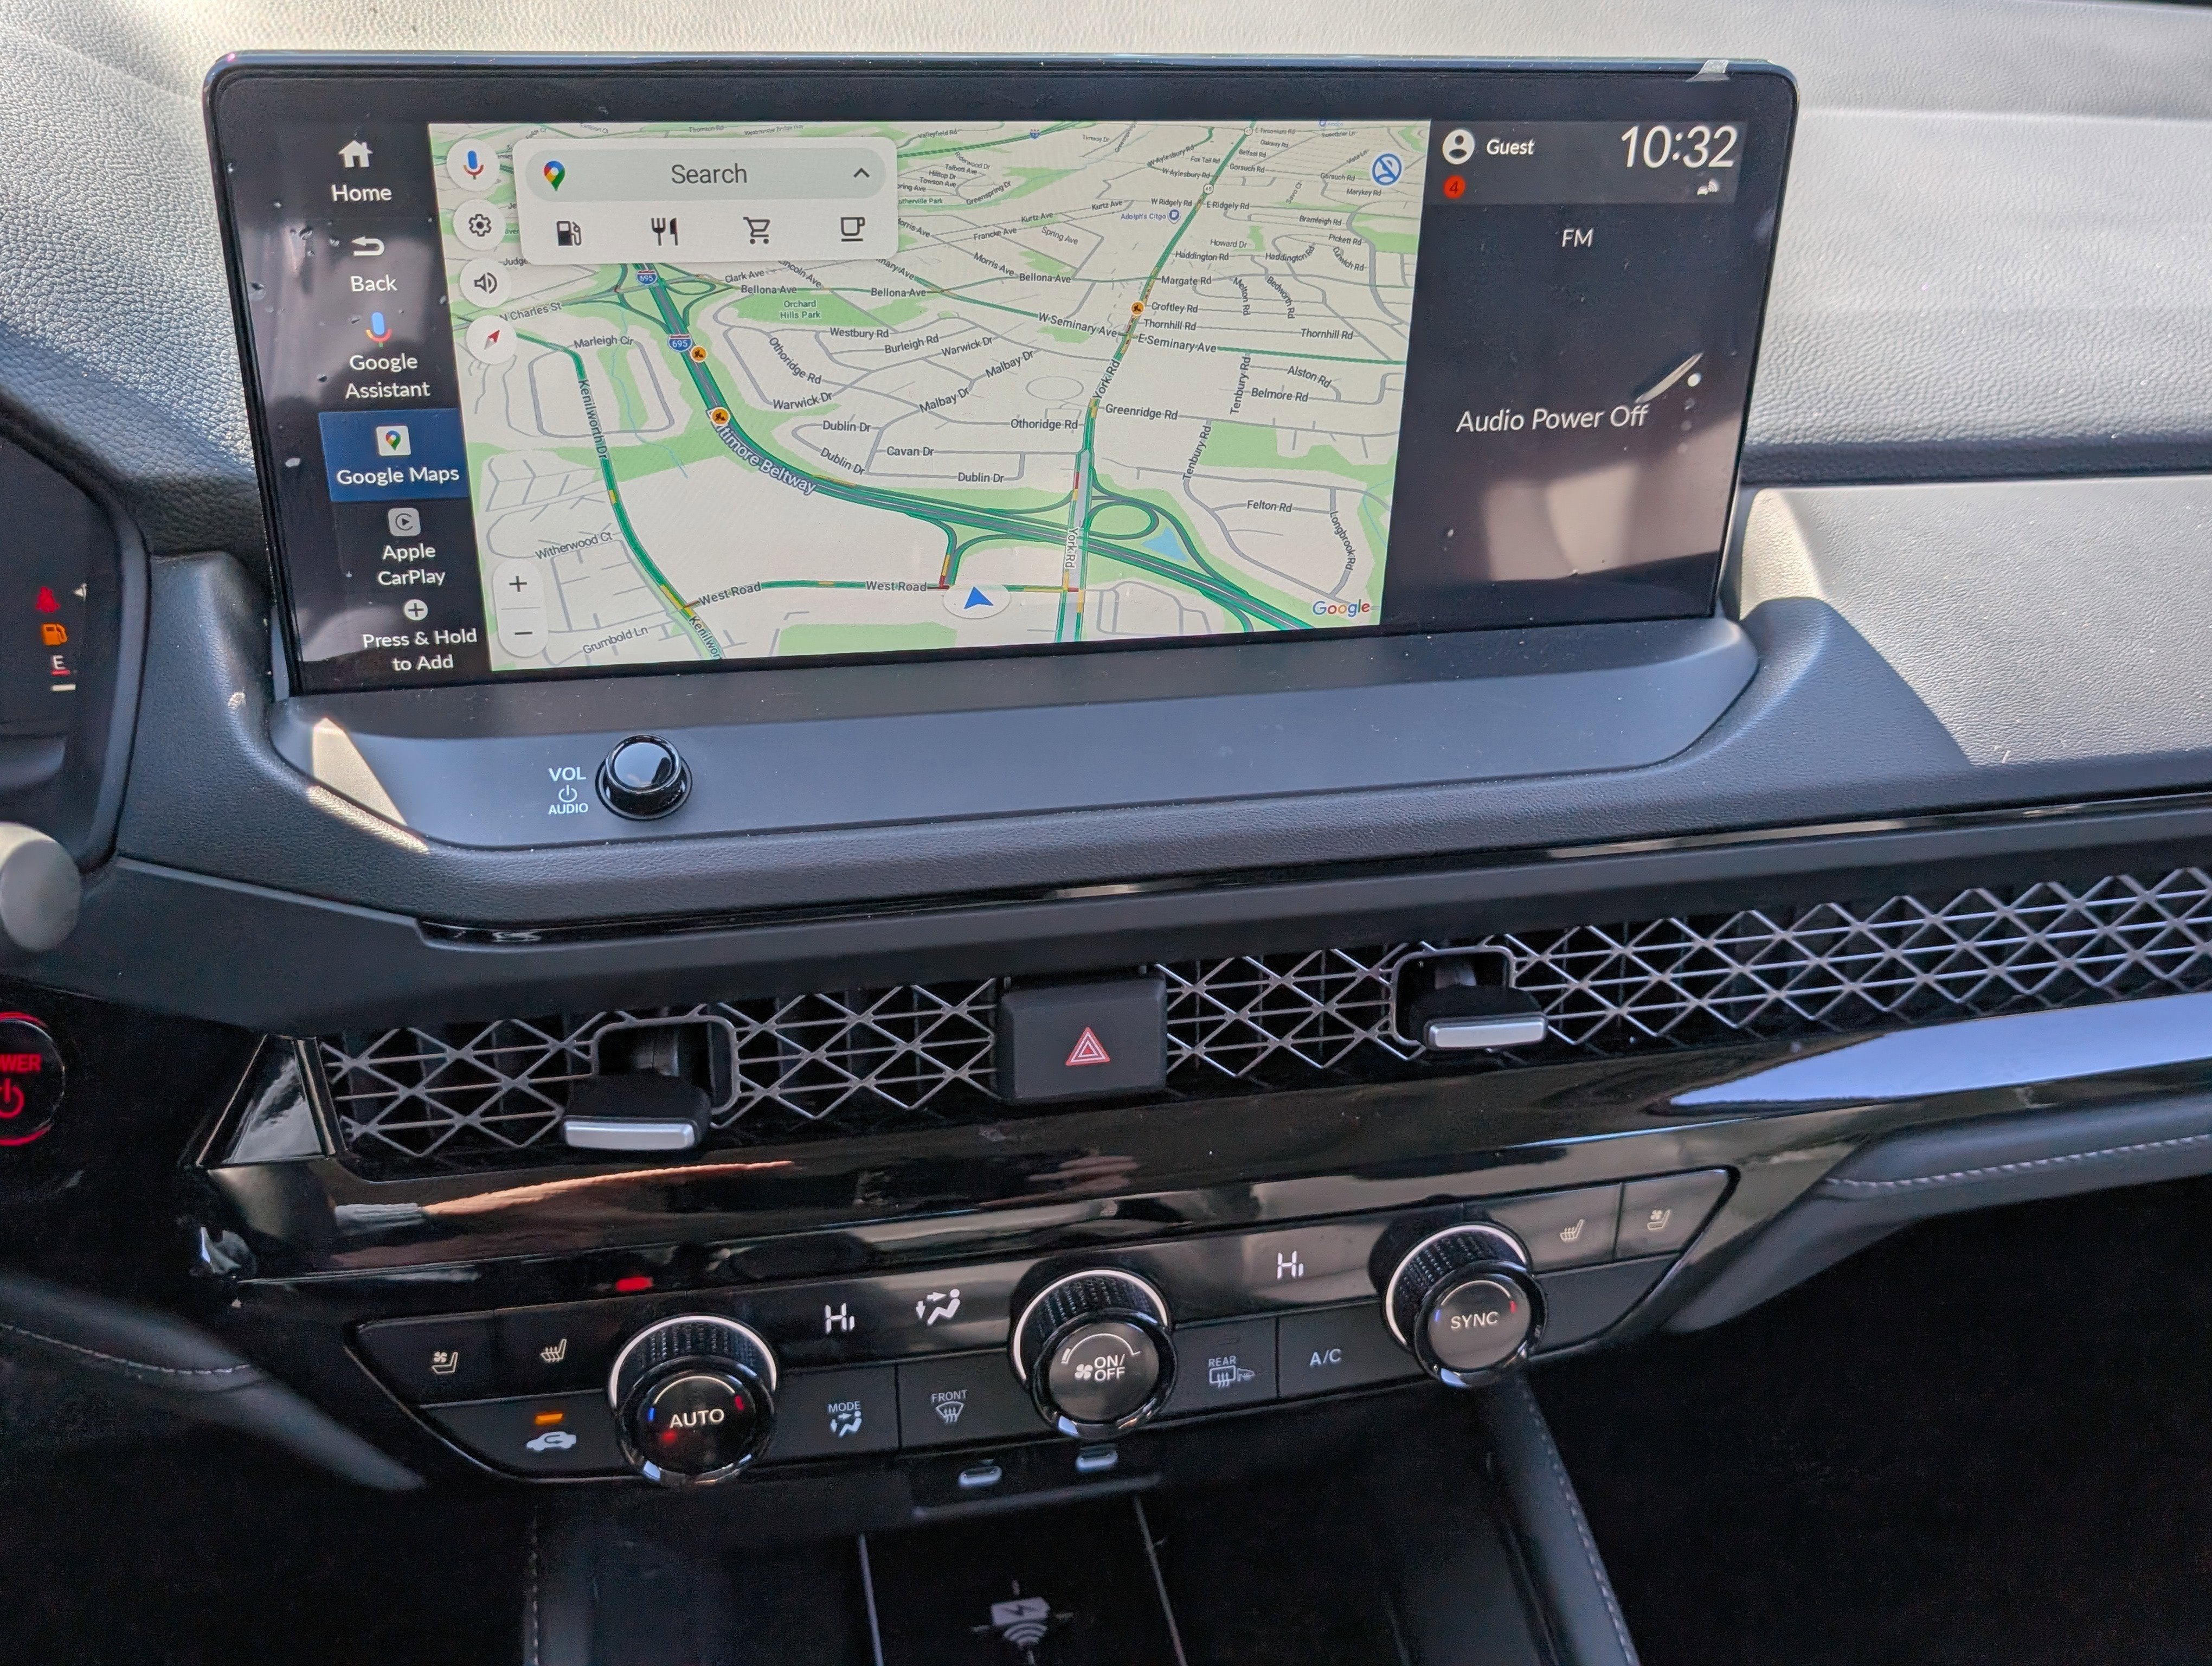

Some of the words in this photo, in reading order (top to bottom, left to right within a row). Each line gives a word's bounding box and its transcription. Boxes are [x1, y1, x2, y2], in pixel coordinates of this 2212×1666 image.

[1487, 138, 1535, 155] Guest
[1621, 125, 1737, 169] 10:32
[671, 163, 747, 184] Search
[331, 184, 392, 202] Home
[1449, 181, 1458, 194] 4
[1092, 203, 1109, 211] Kurtz
[1159, 198, 1182, 207] Ridgely
[1212, 201, 1238, 210] Ridgely
[1021, 214, 1039, 223] Kurtz
[1041, 227, 1063, 241] Spring
[1064, 235, 1078, 245] Ave
[1561, 228, 1594, 247] FM
[1175, 251, 1217, 262] Haddington
[1306, 245, 1315, 256] Rd
[974, 252, 999, 270] Morris
[999, 265, 1014, 277] Ave
[350, 274, 397, 292] Back
[725, 273, 747, 283] Clark
[749, 270, 765, 279] Ave
[1020, 273, 1052, 282] Bellona
[1054, 274, 1071, 283] Ave
[1161, 275, 1198, 286] Margate
[1200, 276, 1212, 285] Rd
[741, 285, 776, 294] Bellona
[780, 286, 797, 294] Ave
[871, 287, 905, 297] Bellona
[909, 288, 926, 296] Ave
[1267, 276, 1293, 307] Bedworth
[1287, 307, 1295, 319] Rd
[510, 306, 549, 320] Charles
[550, 302, 562, 311] St
[1152, 302, 1185, 314] Croftley
[1187, 304, 1198, 313] Rd
[1242, 304, 1251, 316] Rd
[1038, 312, 1049, 322] W
[1051, 315, 1098, 335] Seminary
[1098, 328, 1117, 337] Ave
[1143, 318, 1182, 330] Thornhill
[1185, 322, 1197, 331] Rd
[574, 336, 617, 349] Marleigh
[620, 335, 634, 345] Cir
[830, 327, 873, 340] Westbury
[876, 330, 889, 338] Rd
[1301, 328, 1339, 339] Thornhill
[1341, 331, 1353, 340] Rd
[885, 339, 924, 354] Burleigh
[926, 334, 940, 344] Rd
[941, 341, 980, 356] Warwick
[980, 336, 993, 347] Dr
[1147, 335, 1195, 353] Seminary
[1197, 342, 1217, 353] Ave
[349, 353, 418, 372] Google
[770, 337, 806, 378] Othoridge
[807, 373, 822, 385] Rd
[986, 357, 1020, 377] Malbay
[1022, 350, 1034, 360] Dr
[1092, 377, 1111, 399] York
[1106, 359, 1121, 377] Rd
[1230, 371, 1249, 415] Tenbury
[1240, 356, 1251, 371] Rd
[1287, 366, 1317, 381] Alston
[1317, 376, 1332, 388] Rd
[345, 381, 430, 400] Assistant
[1251, 388, 1293, 400] Belmore
[1295, 392, 1309, 402] Rd
[773, 396, 819, 409] Warwick
[821, 392, 833, 402] Dr
[919, 393, 956, 413] Malbay
[957, 387, 970, 398] Dr
[579, 380, 605, 444] Kenilworth
[596, 445, 608, 459] Dr
[1105, 404, 1161, 419] Greenridge
[1164, 410, 1178, 420] Rd
[1456, 409, 1524, 432] Audio
[1532, 408, 1604, 430] Power
[1610, 404, 1649, 426] Off
[823, 420, 856, 432] Dublin
[859, 423, 871, 432] Dr
[1011, 419, 1061, 431] Othoridge
[1064, 419, 1078, 429] Rd
[706, 409, 760, 466] ltimore
[760, 459, 816, 496] Beltway
[887, 447, 919, 456] Cavan
[923, 447, 934, 456] Dr
[1182, 438, 1206, 480] Tenbury
[1200, 425, 1212, 439] Rd
[820, 447, 853, 471] Dublin
[852, 464, 865, 475] Dr
[337, 467, 404, 486] Google
[409, 467, 459, 484] Maps
[958, 472, 990, 483] Dublin
[993, 473, 1004, 483] Dr
[1246, 500, 1277, 510] Felton
[1279, 503, 1293, 512] Rd
[535, 535, 599, 560] Witherwood
[600, 531, 613, 542] Ct
[1067, 528, 1079, 551] York
[1330, 511, 1354, 557] Longbrook
[1345, 555, 1356, 571] Rd
[382, 543, 436, 562] Apple
[1065, 554, 1076, 568] Rd
[378, 569, 446, 586] CarPlay
[699, 589, 729, 606] West
[731, 582, 762, 597] Road
[866, 581, 896, 591] West
[898, 582, 927, 592] Road
[1313, 599, 1371, 617] Google
[363, 633, 409, 648] Press
[414, 632, 429, 645] &
[434, 628, 477, 644] Hold
[583, 631, 632, 655] Grumbold
[633, 626, 648, 639] Ln
[53, 655, 65, 670] E
[393, 658, 412, 671] to
[417, 654, 453, 670] Add
[548, 767, 587, 781] VOL
[548, 803, 589, 815] AUDIO
[1450, 1310, 1499, 1330] SYNC
[1094, 1354, 1125, 1369] ON/
[1208, 1356, 1237, 1367] REAR
[1309, 1348, 1342, 1367] A/C
[1094, 1367, 1126, 1381] OFF
[931, 1389, 968, 1404] FRONT
[828, 1400, 861, 1413] MODE
[670, 1408, 725, 1429] AUTO
